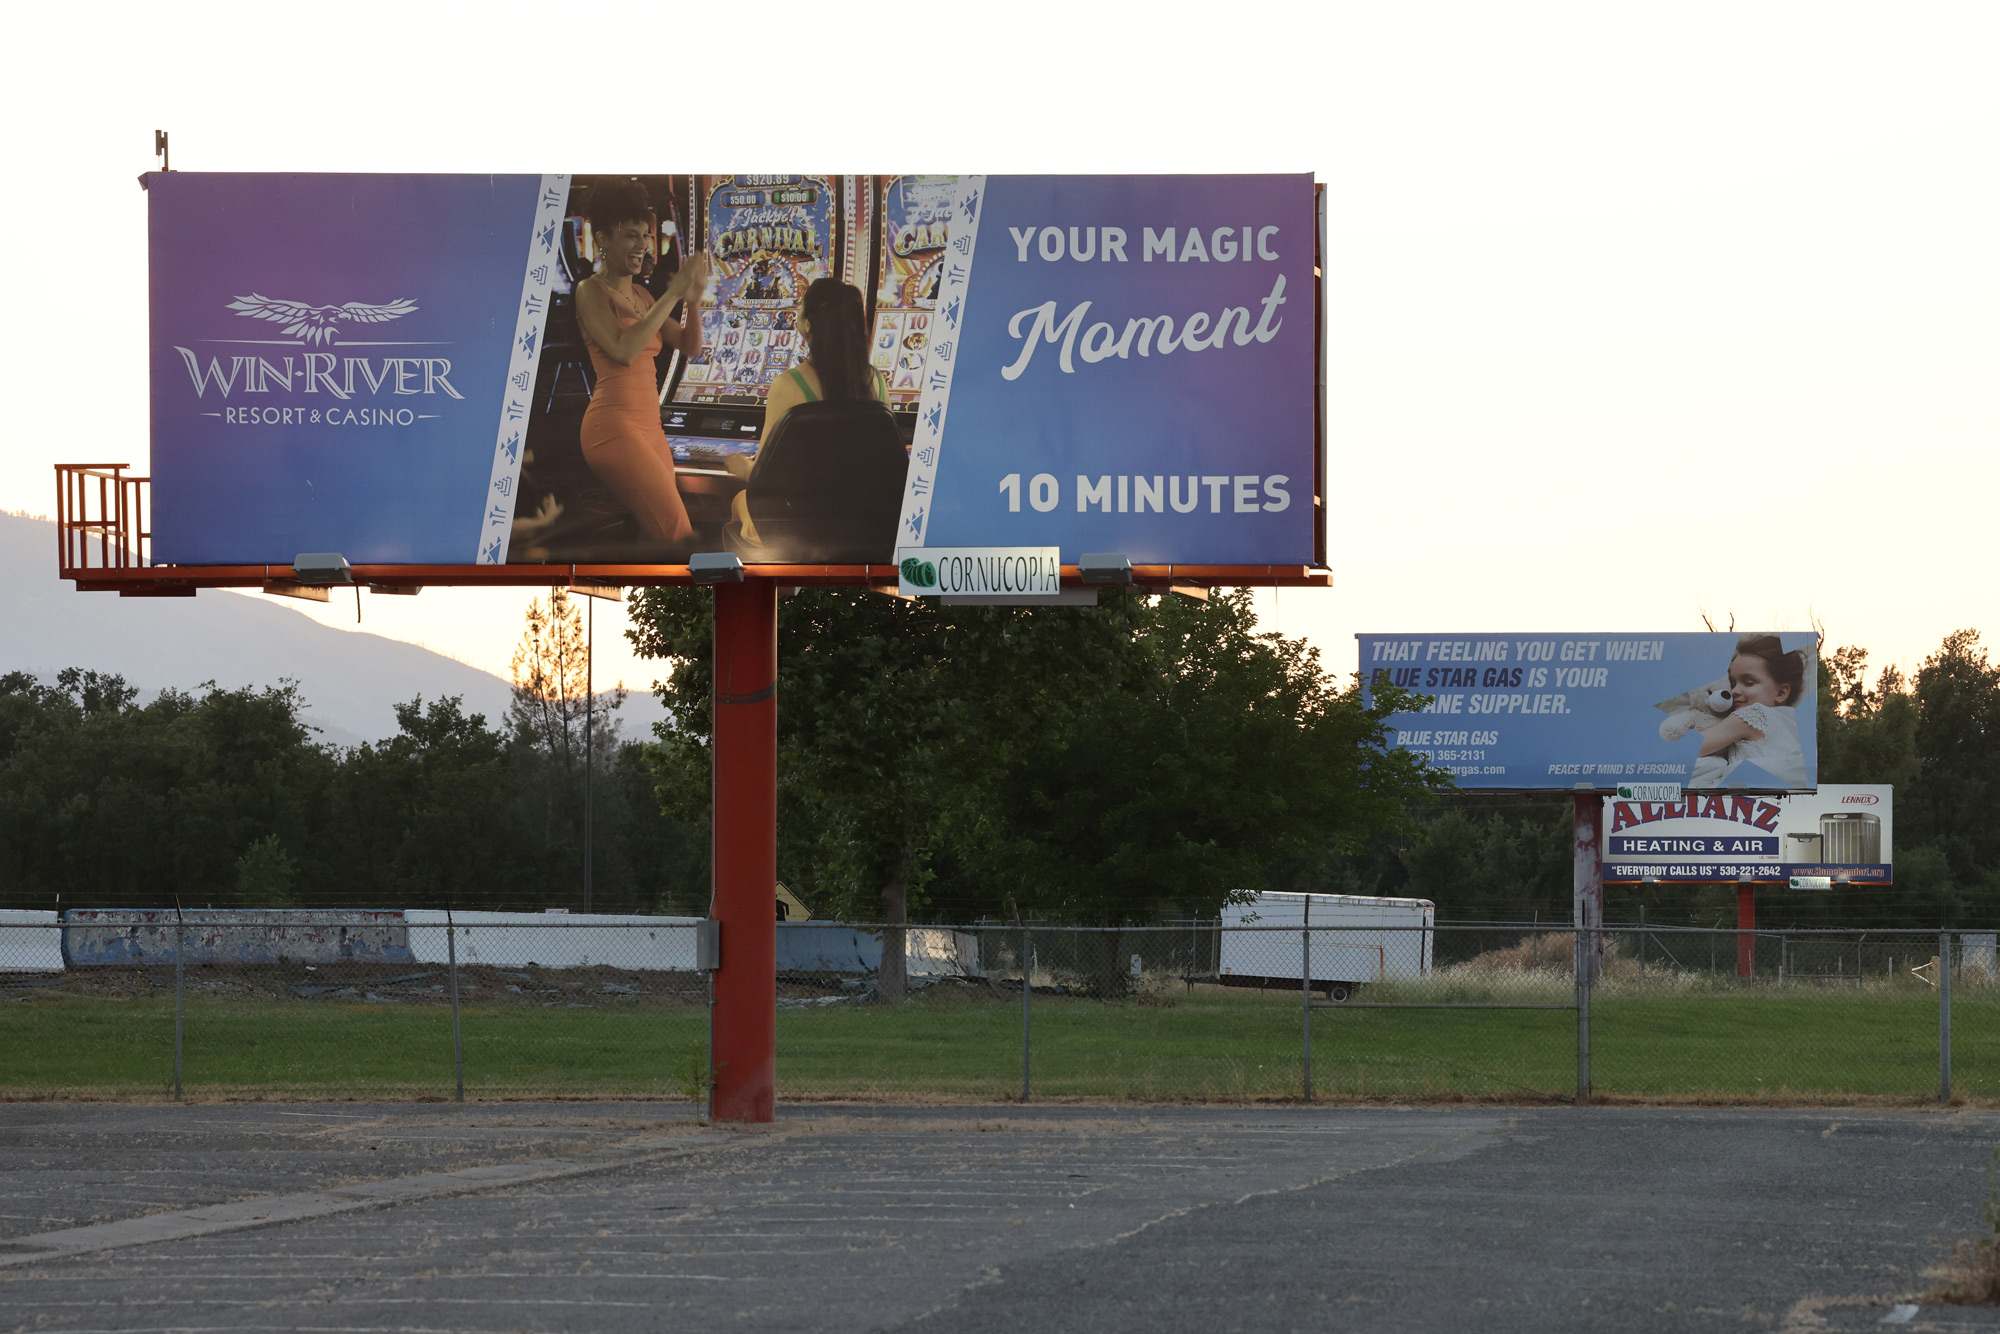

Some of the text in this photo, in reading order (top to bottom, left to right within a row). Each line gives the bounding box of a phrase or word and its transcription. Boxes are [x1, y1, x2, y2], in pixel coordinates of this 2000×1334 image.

[730, 195, 756, 205] $50.00
[781, 192, 807, 202] $10.00
[714, 227, 823, 258] CARNIVAL
[1008, 225, 1280, 263] YOUR MAGIC
[1001, 274, 1287, 381] Moment
[226, 407, 414, 426] RESORT & CASINO
[999, 473, 1291, 513] 10 MINUTES
[938, 556, 1058, 593] CORNUCOPIA
[1372, 640, 1665, 662] THAT FEELING YOU GET WHEN
[1370, 667, 1608, 688] BUE STAR GAS IS YOUR
[1468, 693, 1571, 714] SUPPLIER.
[1396, 730, 1499, 746] BLUE STAR GAS
[1437, 750, 1485, 761] 365-2131
[1548, 763, 1687, 775] PEACE OF MIND IS PERSONAL
[1632, 785, 1681, 801] CORNUCOPIA
[1841, 796, 1871, 804] LENNOX
[1611, 795, 1780, 834] ALLIANZ
[1623, 840, 1763, 852] HEATING & AIR
[1670, 865, 1697, 876] CALLS
[1719, 865, 1781, 876] 530-221-2642
[1791, 866, 1885, 878] www.HomeComfort.org
